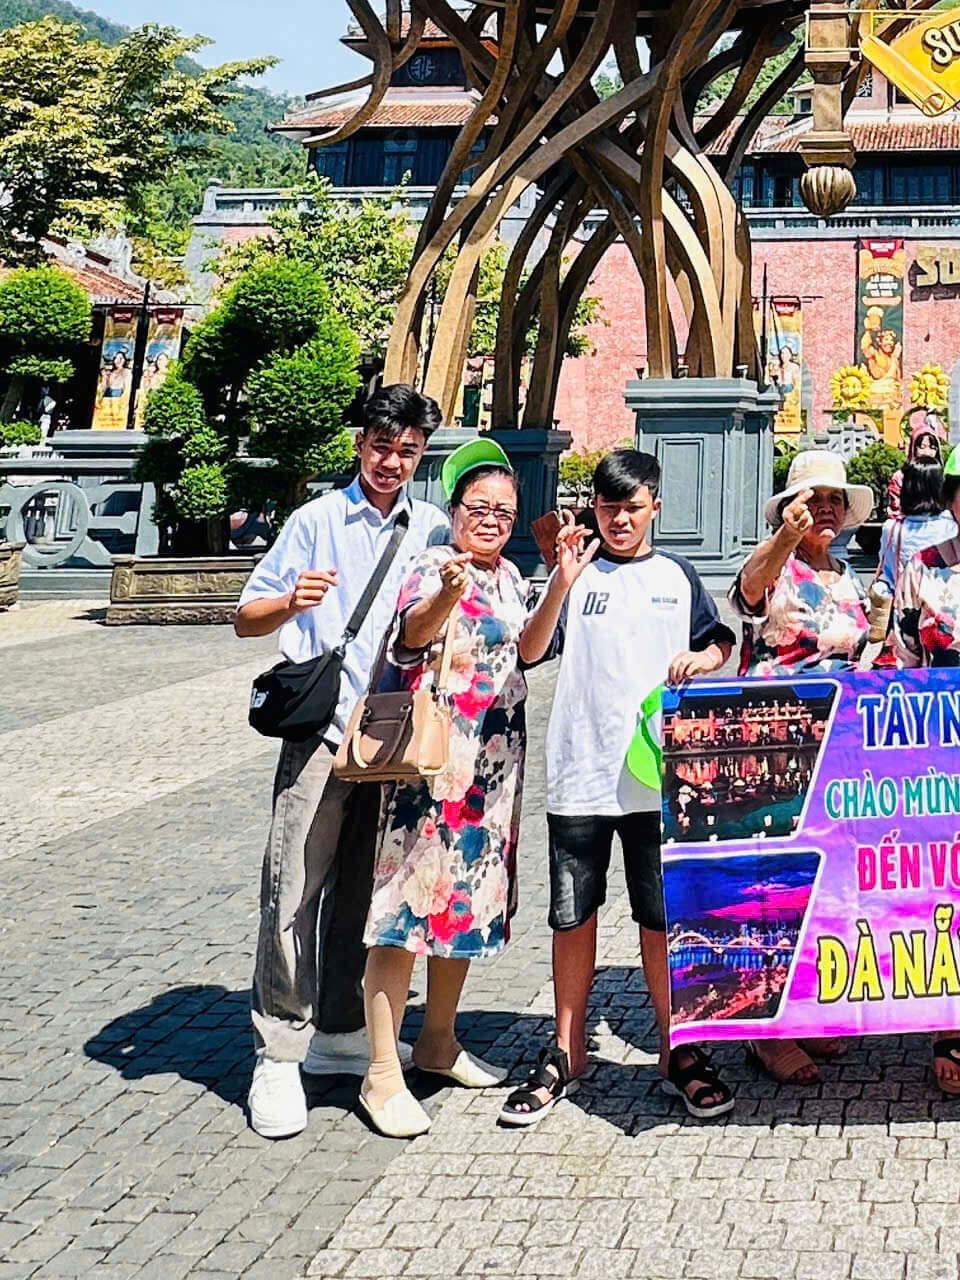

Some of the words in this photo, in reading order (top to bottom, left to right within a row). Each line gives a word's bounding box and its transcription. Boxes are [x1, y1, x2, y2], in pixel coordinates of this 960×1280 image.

[582, 591, 610, 616] 02
[857, 683, 933, 750] TÂY
[826, 770, 897, 818] CHÀO
[857, 830, 921, 891] ĐẾN
[816, 919, 884, 1003] ĐÀ
